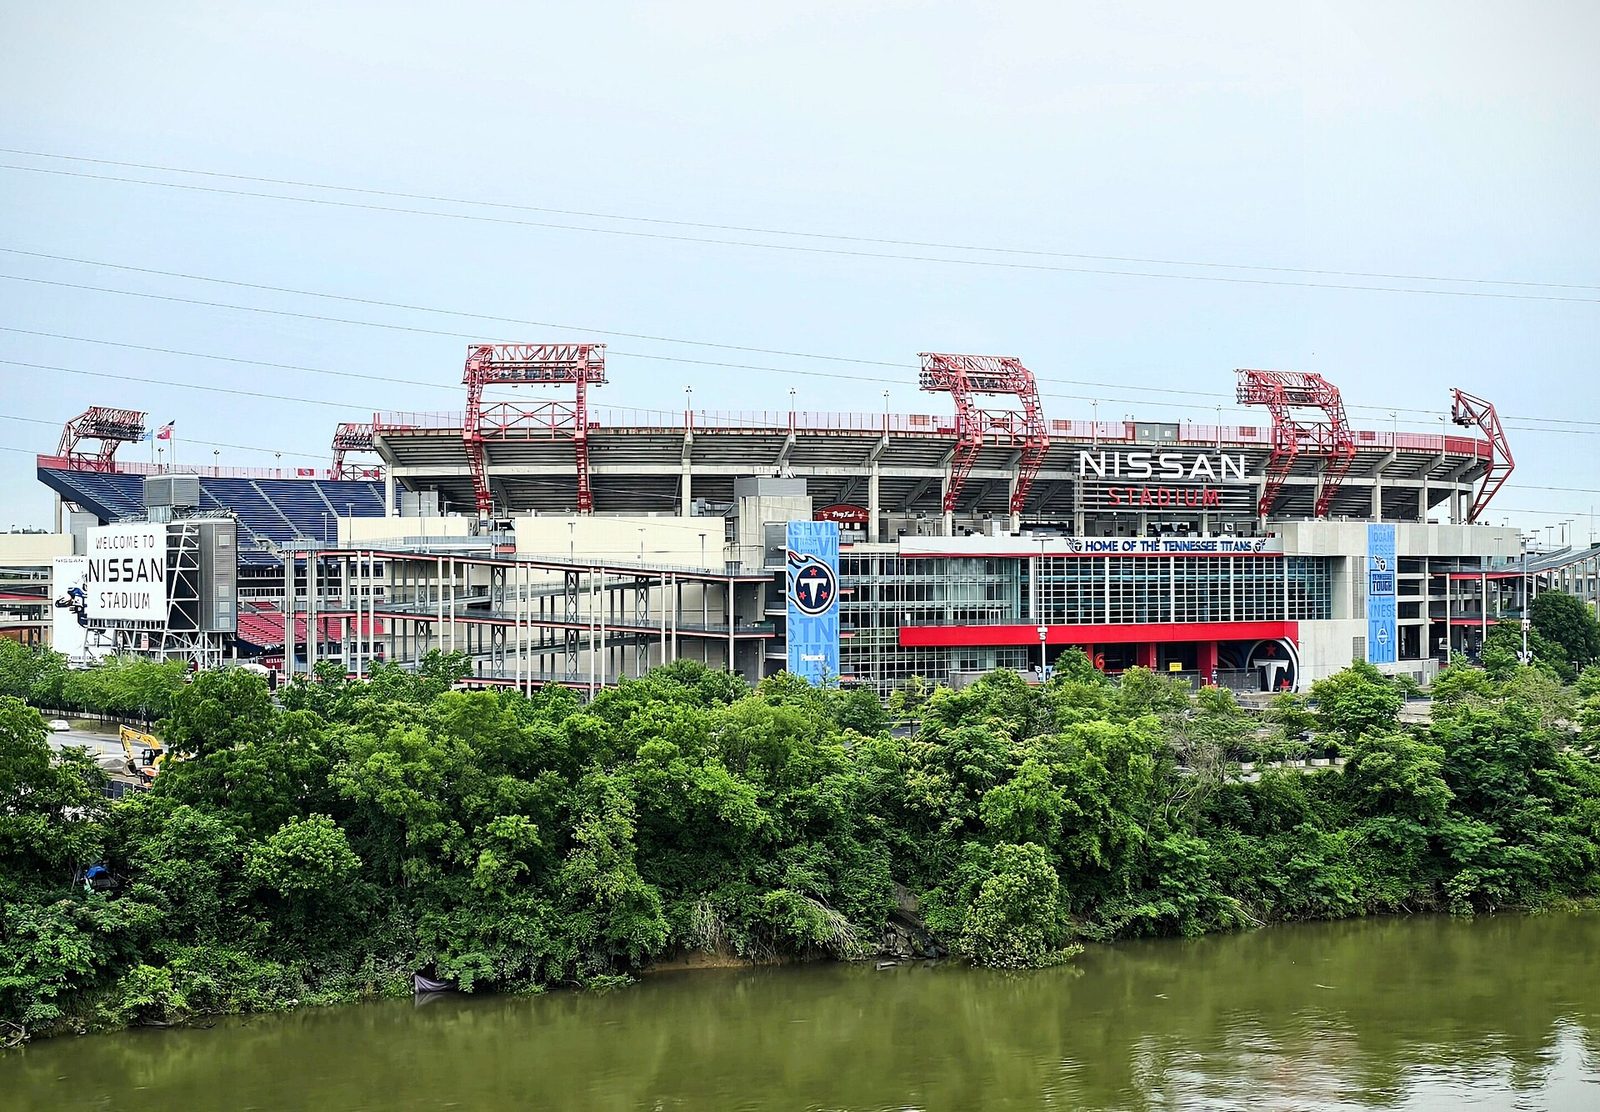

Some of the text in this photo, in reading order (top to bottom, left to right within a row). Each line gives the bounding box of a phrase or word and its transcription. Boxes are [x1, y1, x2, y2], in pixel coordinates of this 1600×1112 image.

[1079, 450, 1245, 480] NISSAN
[1108, 487, 1220, 507] STADIUM
[95, 534, 155, 550] WELCOME TO
[1085, 540, 1252, 552] HOME OF THE TENNESSEE TITANS
[89, 557, 164, 583] NISSAN
[1372, 581, 1393, 592] TOUGH
[100, 591, 151, 610] STADIUM
